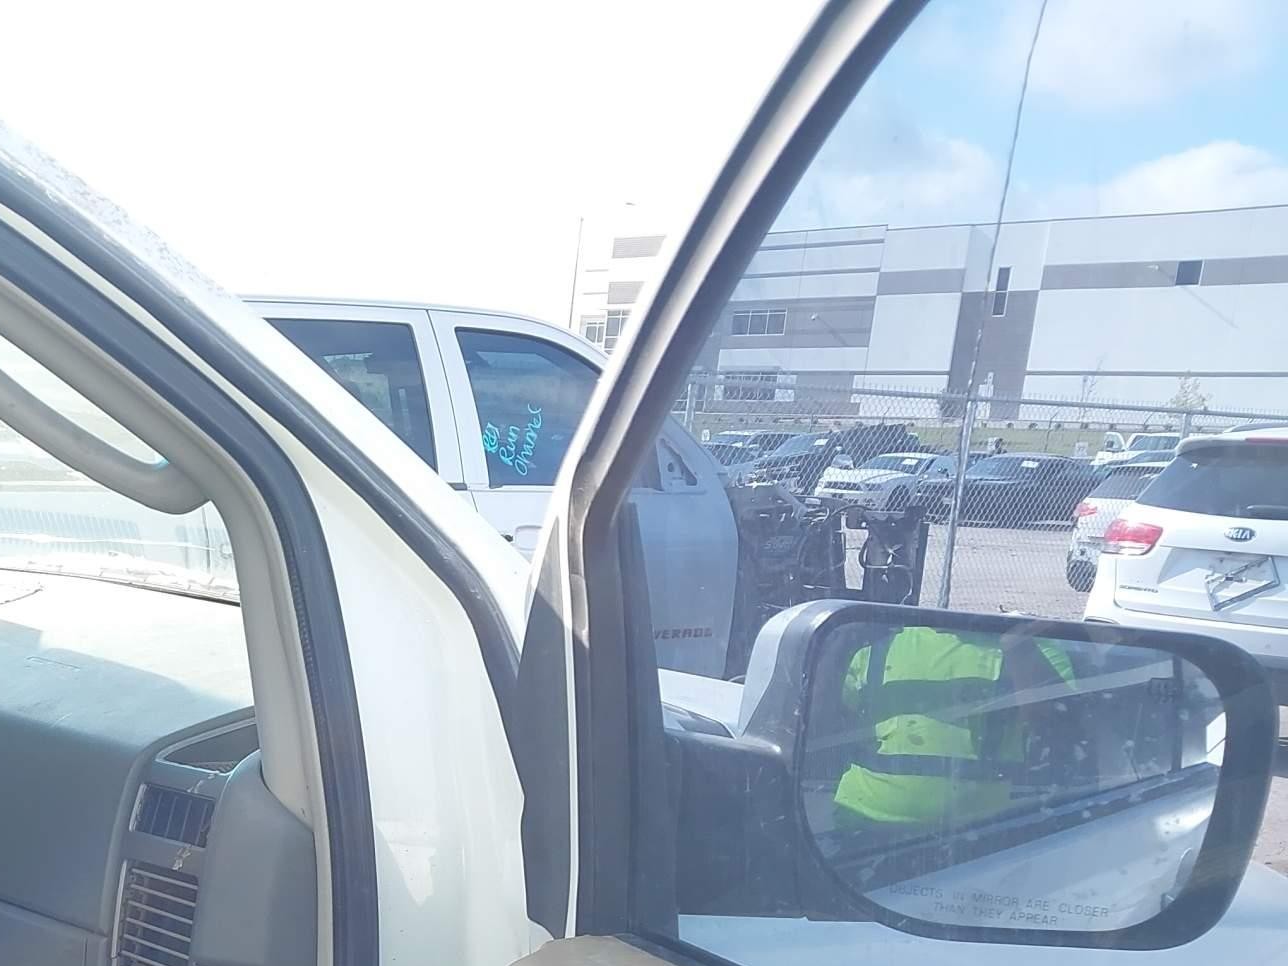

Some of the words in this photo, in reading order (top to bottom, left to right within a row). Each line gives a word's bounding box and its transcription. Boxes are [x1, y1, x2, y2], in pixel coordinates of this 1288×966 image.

[499, 425, 520, 466] Run
[888, 886, 943, 899] OBJECTS
[973, 892, 1018, 907] MIRROR
[1025, 899, 1049, 912] ARE
[1058, 902, 1109, 918] CLOSER
[933, 901, 966, 914] THAN
[973, 906, 1002, 920] THEY
[1009, 911, 1058, 926] APPEAR
